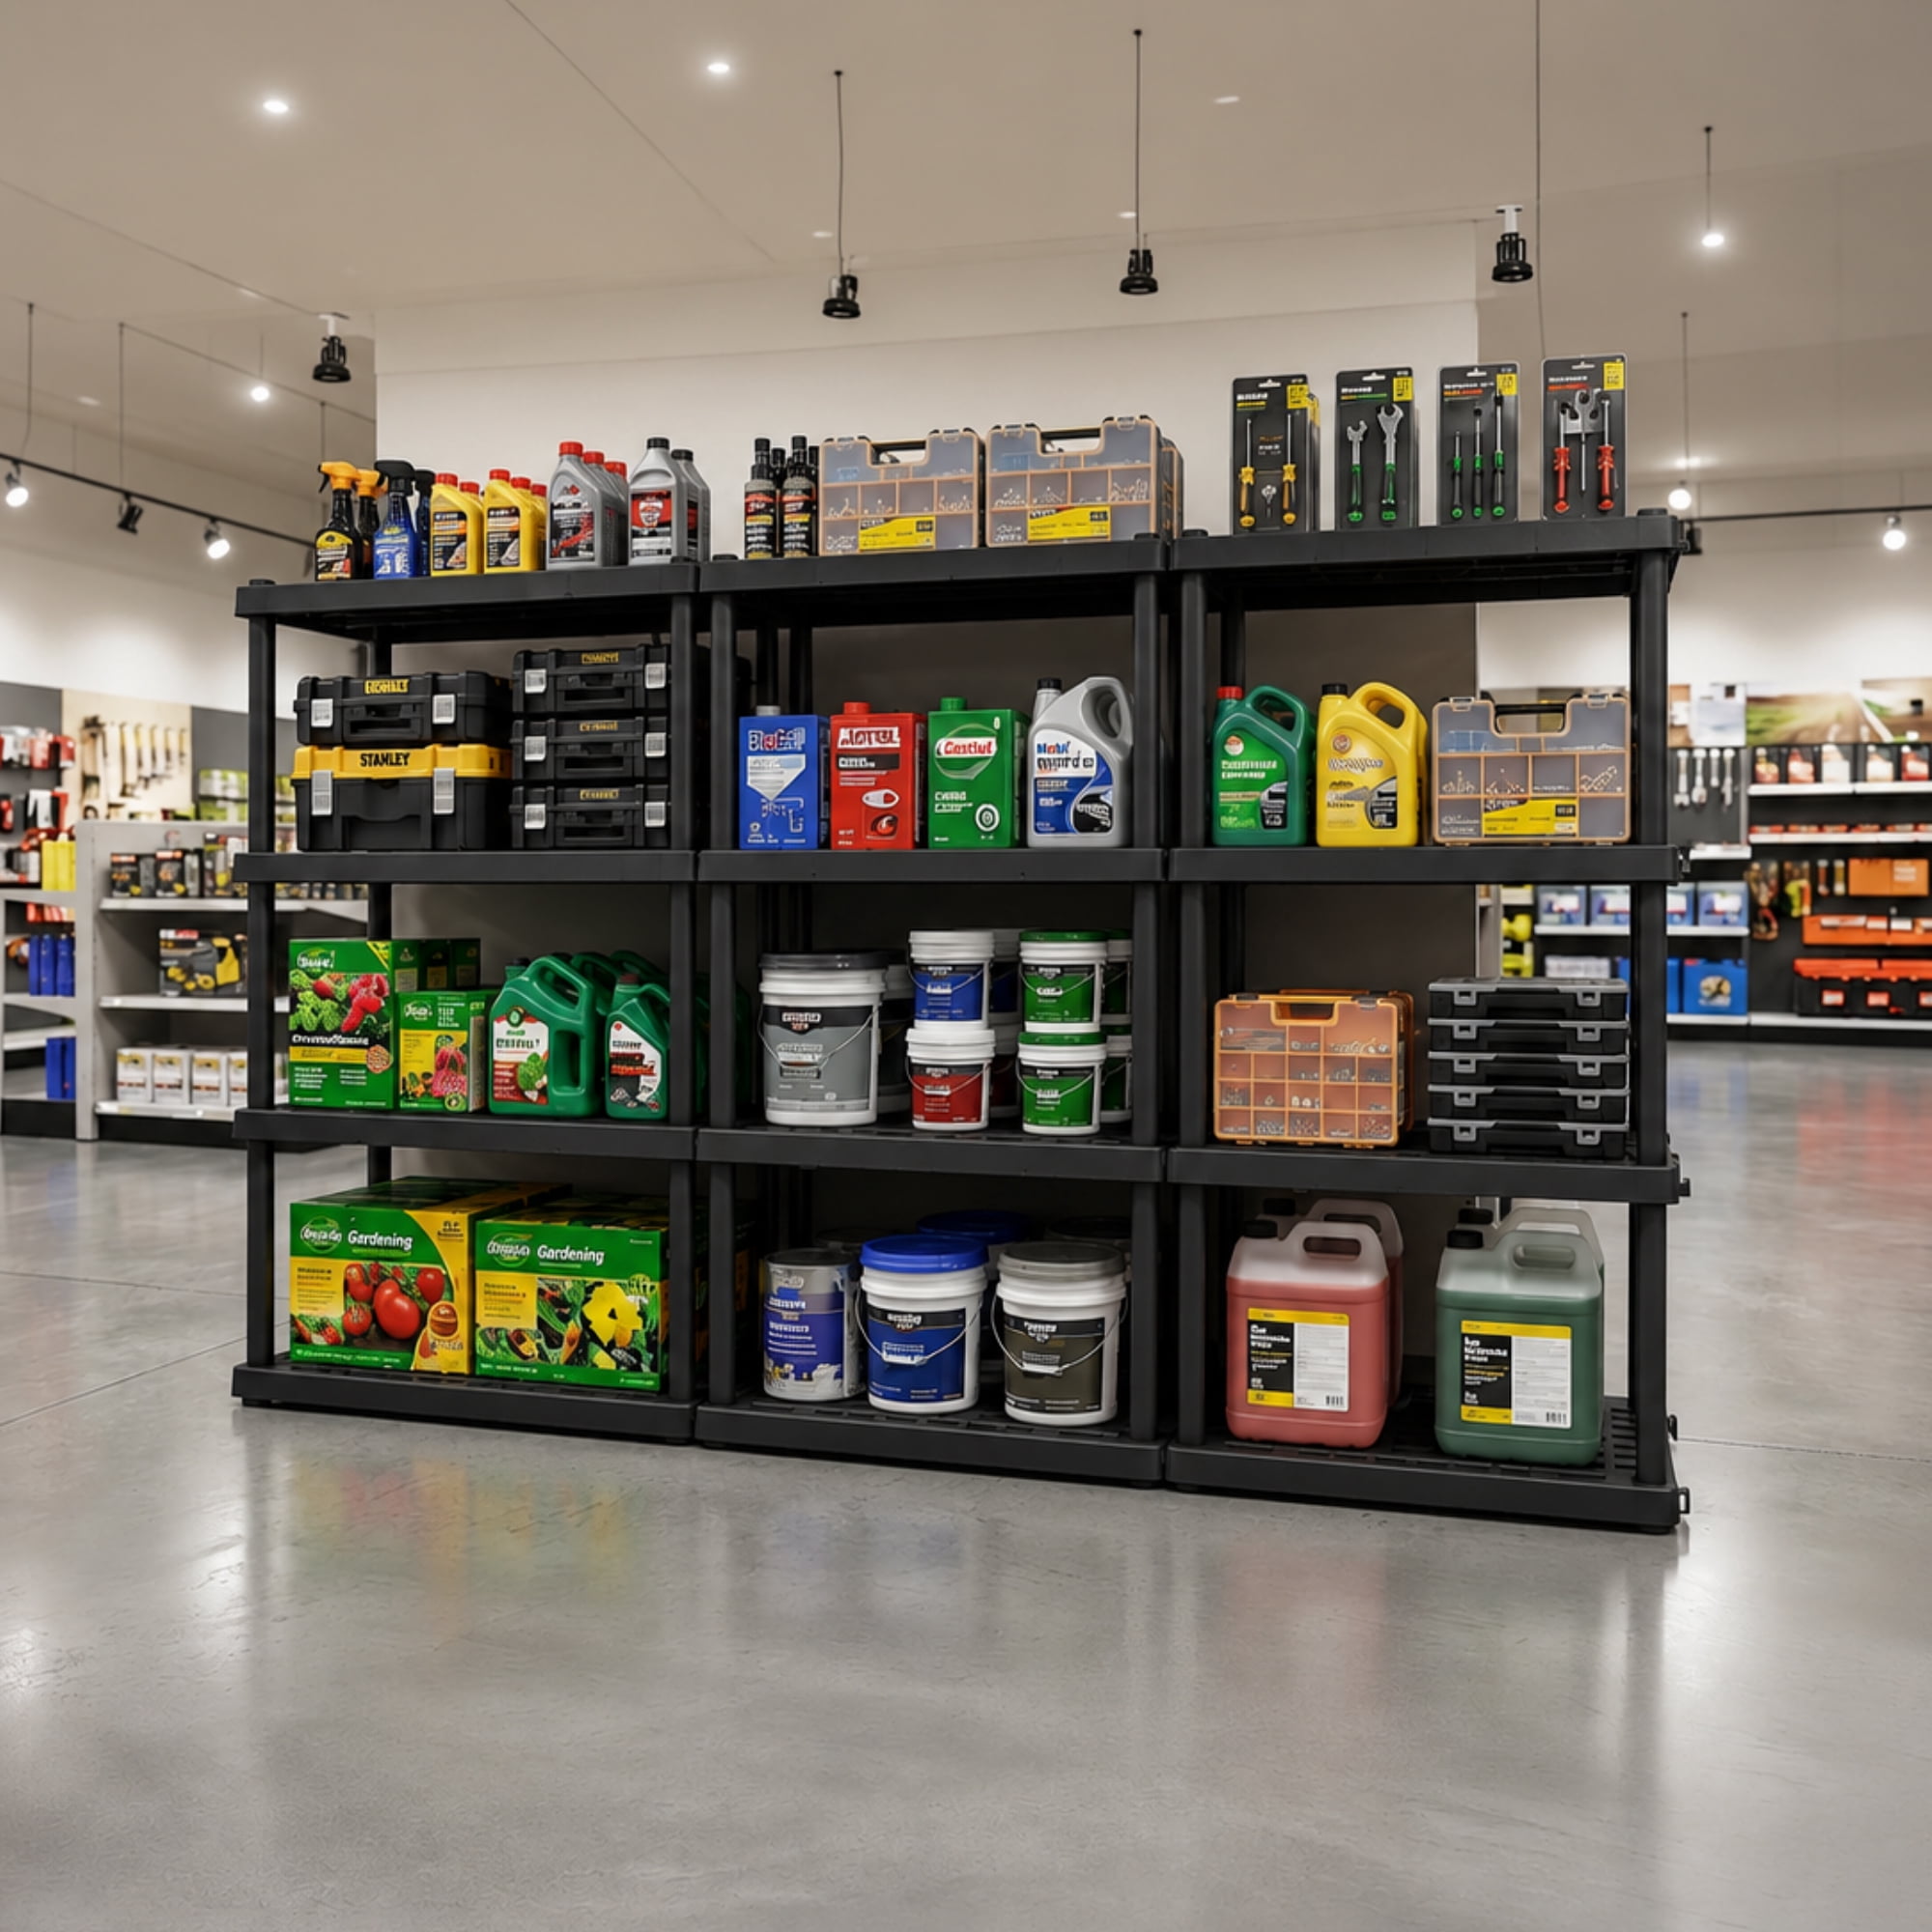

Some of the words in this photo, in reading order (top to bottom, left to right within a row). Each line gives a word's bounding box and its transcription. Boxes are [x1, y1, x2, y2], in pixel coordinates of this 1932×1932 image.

[359, 752, 411, 767] STANLEY
[348, 1230, 412, 1251] Gardening
[537, 1244, 605, 1266] Gardening
